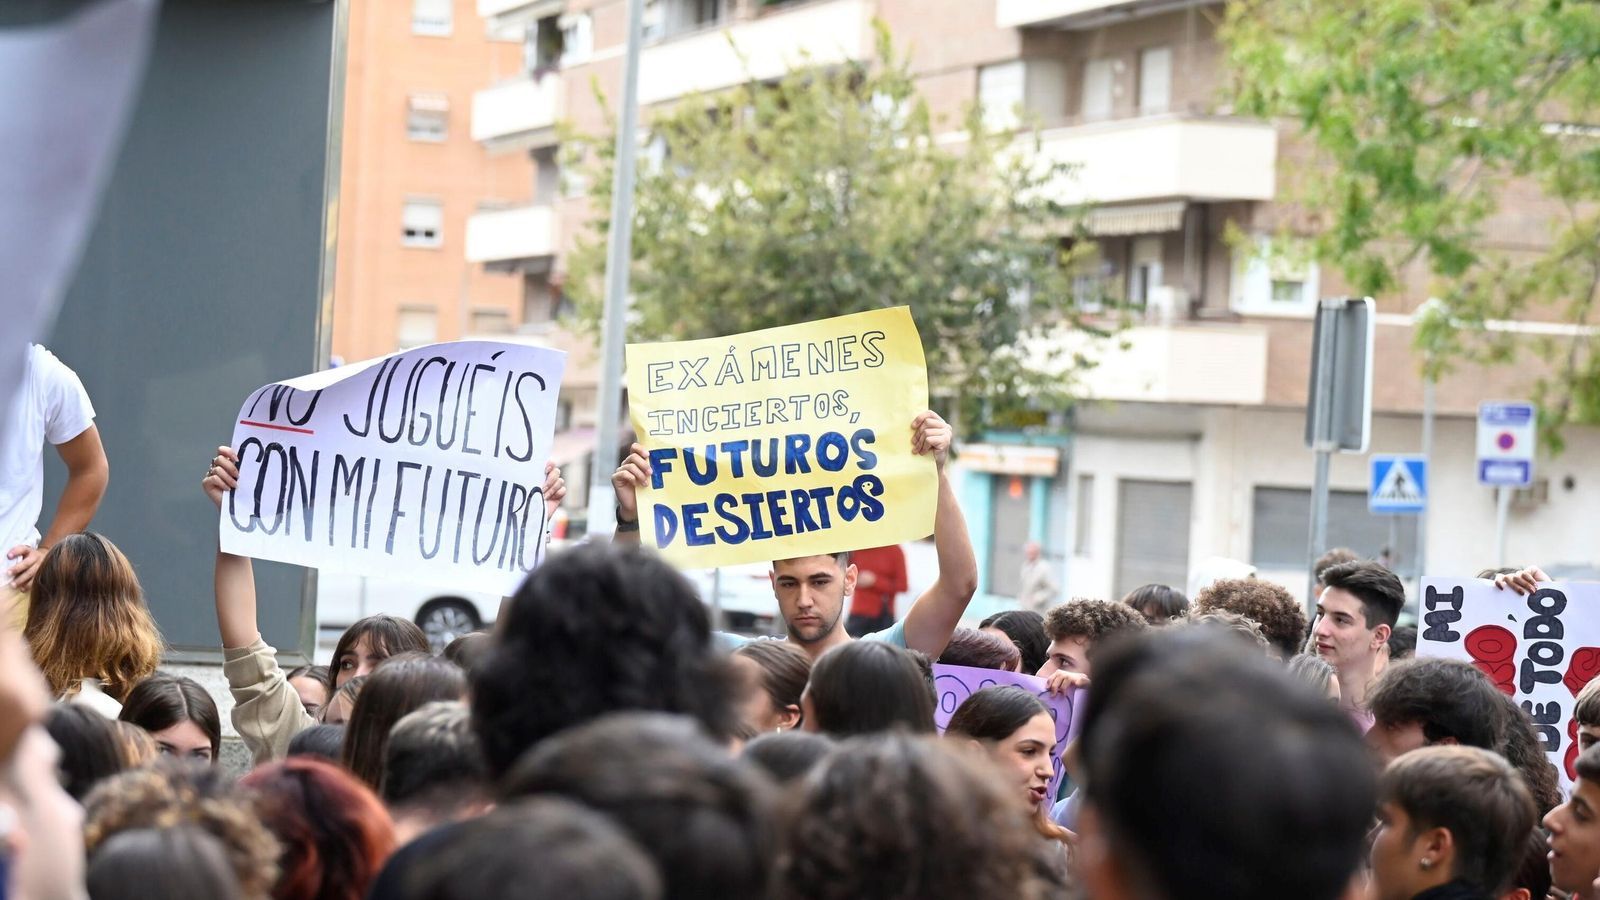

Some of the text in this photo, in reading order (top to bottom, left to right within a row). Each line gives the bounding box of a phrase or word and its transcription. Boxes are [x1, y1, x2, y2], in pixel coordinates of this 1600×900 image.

[647, 331, 886, 393] EXÁMENES
[247, 350, 546, 462] NO JUGUÉIS
[647, 389, 860, 436] INCIERTOS,
[648, 428, 878, 490] FUTUROS
[229, 437, 546, 574] CON MI FUTURO
[653, 474, 885, 549] DESIERTOS
[1422, 584, 1464, 643] MI
[1519, 587, 1568, 695] TODO
